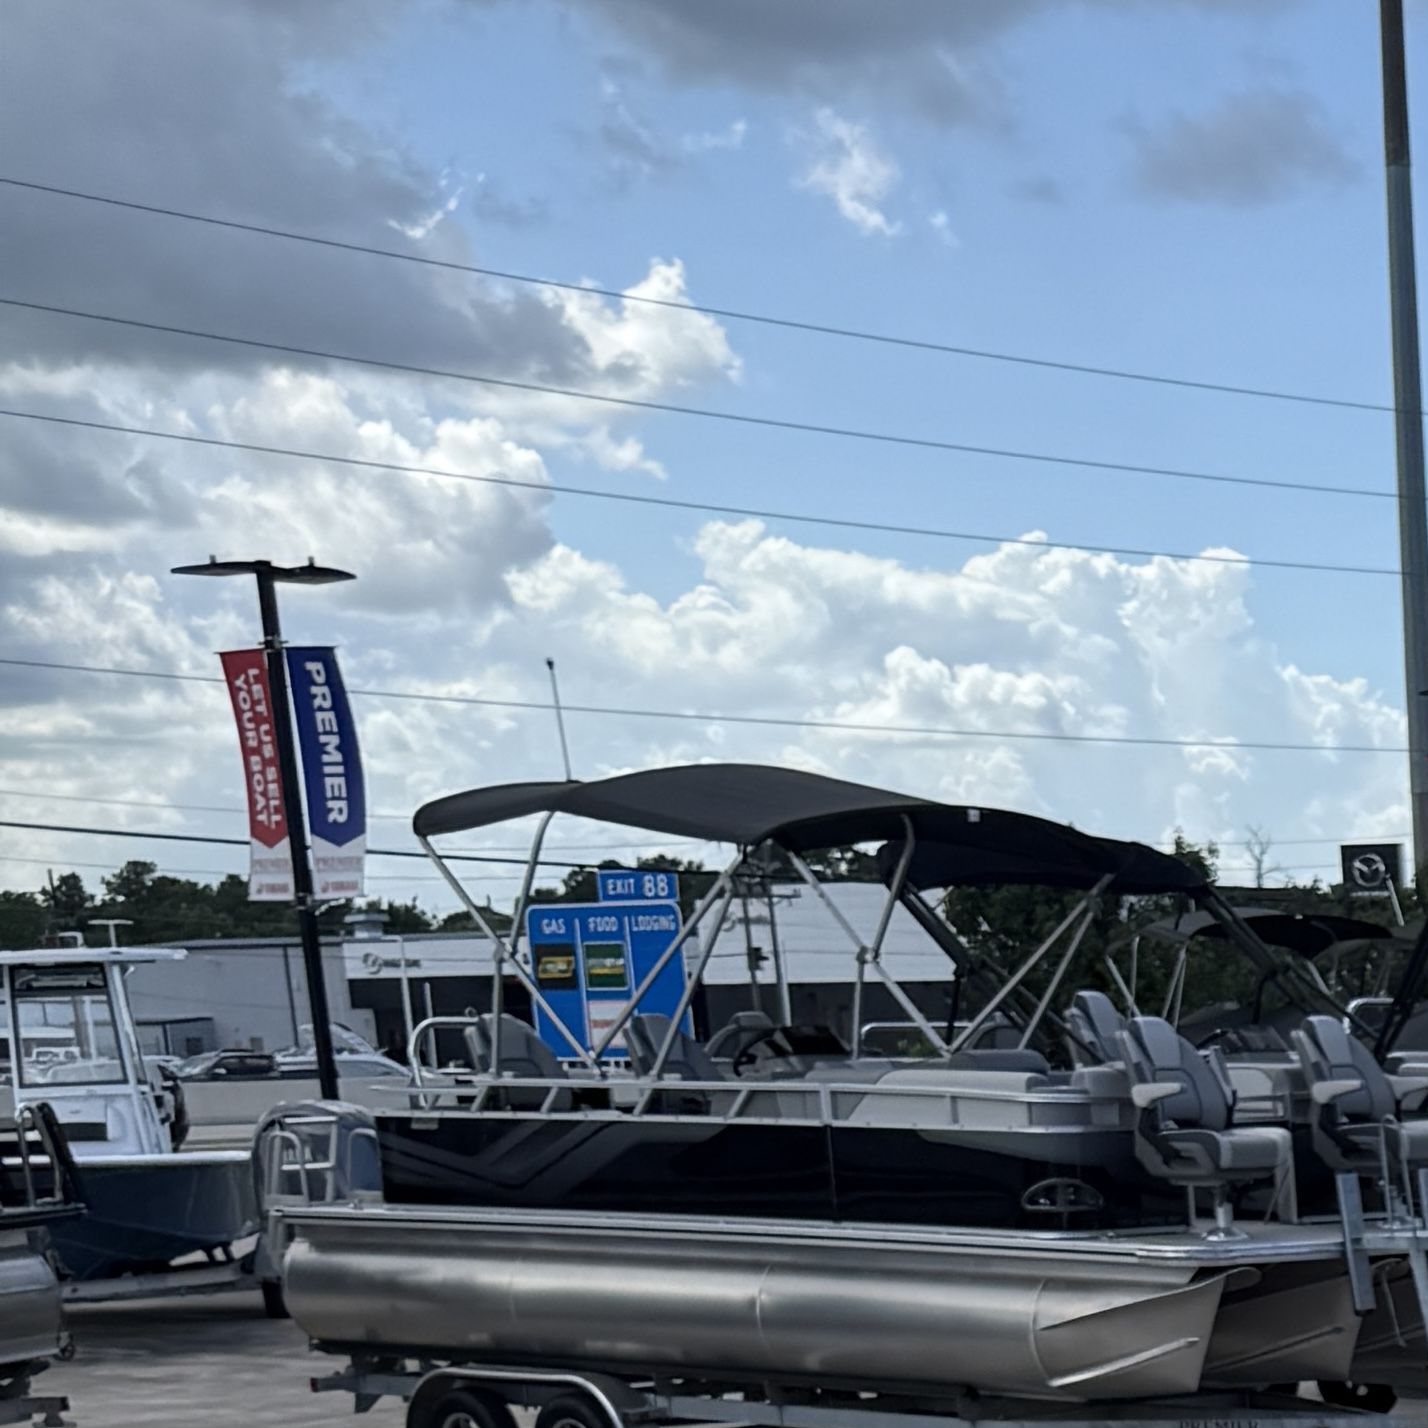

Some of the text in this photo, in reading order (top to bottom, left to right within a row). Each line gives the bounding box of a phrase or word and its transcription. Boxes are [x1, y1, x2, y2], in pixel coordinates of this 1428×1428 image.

[234, 674, 269, 827] YOUR BOAT
[248, 668, 282, 829] LET US SELL
[304, 661, 348, 823] PREMIER
[541, 914, 676, 934] GAS FOOD LODGING
[607, 874, 668, 896] EXIT 88
